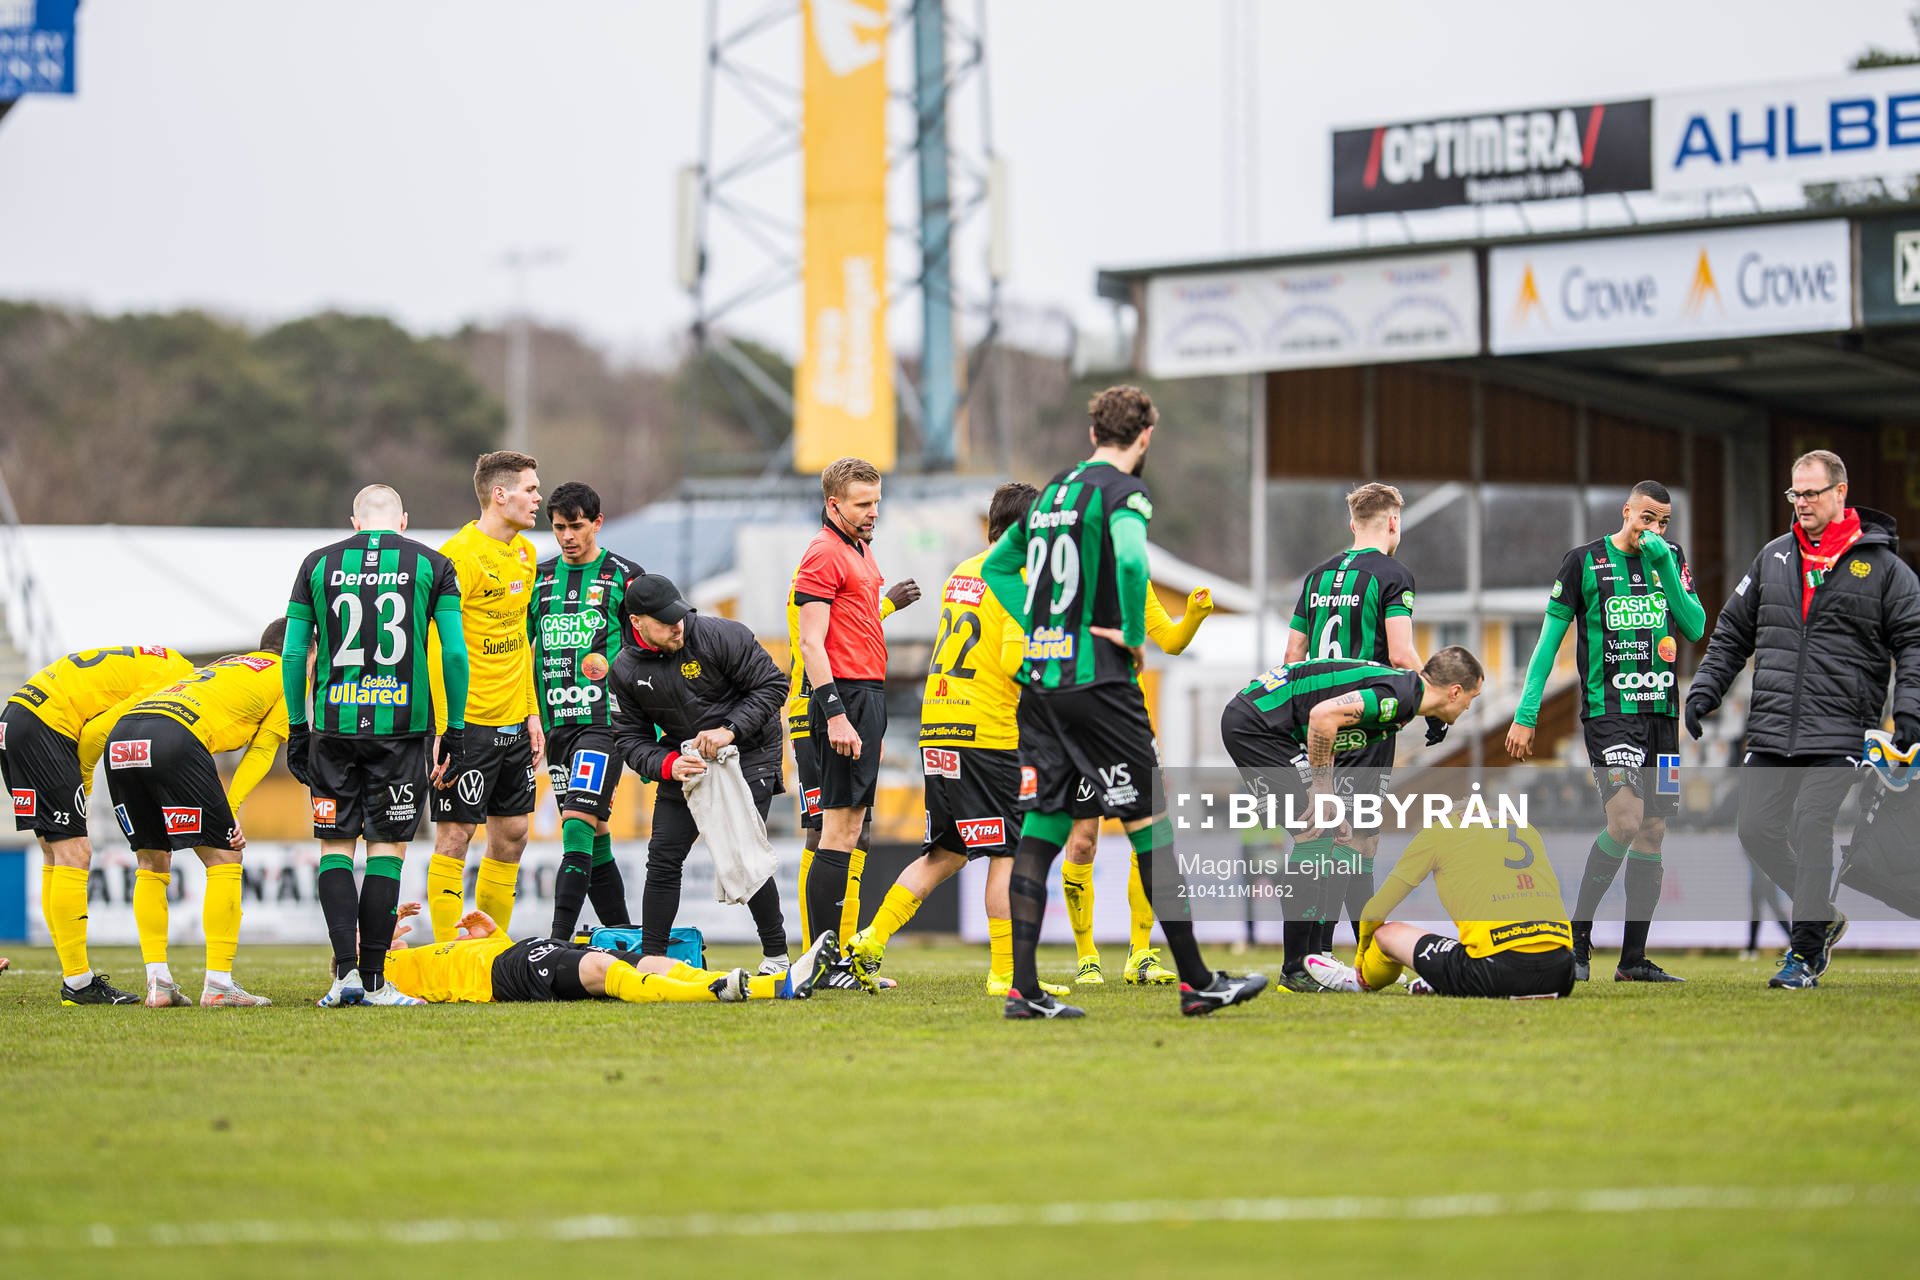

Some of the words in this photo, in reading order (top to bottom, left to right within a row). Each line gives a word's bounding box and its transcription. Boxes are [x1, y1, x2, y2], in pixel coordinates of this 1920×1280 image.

[1738, 250, 1838, 310] Crowe
[1560, 265, 1658, 323] Crowe
[330, 570, 410, 586] Derome
[1023, 533, 1080, 616] 99
[1310, 592, 1360, 608] Derome
[1608, 598, 1650, 612] CASH
[543, 616, 580, 633] CASH
[1610, 611, 1663, 626] BUDDY
[331, 591, 408, 668] 23
[483, 636, 518, 655] Sweden
[544, 631, 592, 646] BUDDY
[929, 607, 982, 680] 22
[1608, 639, 1649, 652] Varbergs
[1605, 651, 1649, 664] Sparbank
[361, 675, 398, 689] Gekås
[1612, 671, 1675, 691] coop
[546, 685, 602, 706] coop
[1623, 691, 1666, 702] VARBERG
[1098, 762, 1132, 788] VS
[389, 783, 414, 804] VS
[439, 798, 452, 812] 16
[53, 811, 71, 825] 23
[162, 812, 197, 829] XTRA
[225, 828, 234, 841] 5
[1517, 873, 1535, 890] JB
